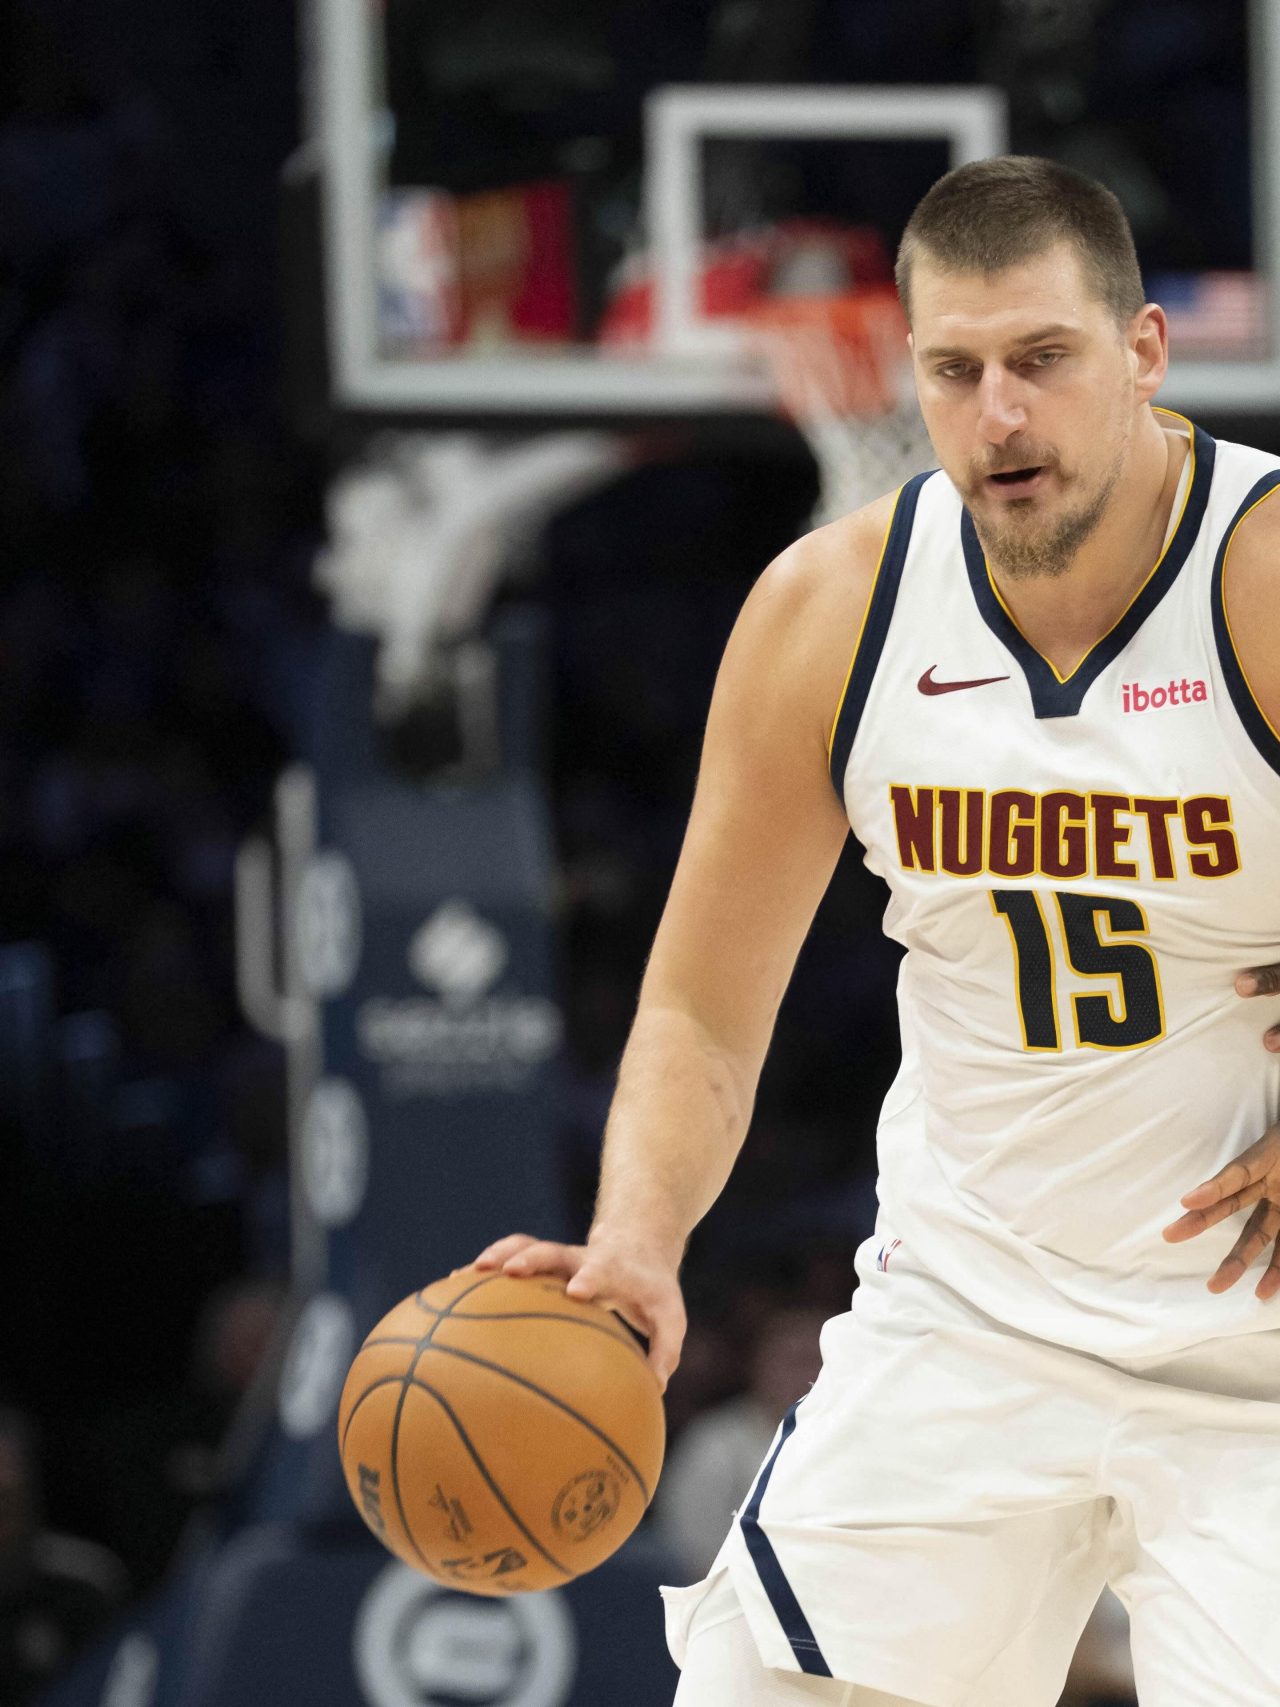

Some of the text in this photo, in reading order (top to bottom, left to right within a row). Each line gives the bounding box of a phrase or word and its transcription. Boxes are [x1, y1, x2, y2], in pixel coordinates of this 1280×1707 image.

[1122, 678, 1208, 713] ibotta
[888, 782, 1243, 881] NUGGETS
[987, 888, 1167, 1053] 15
